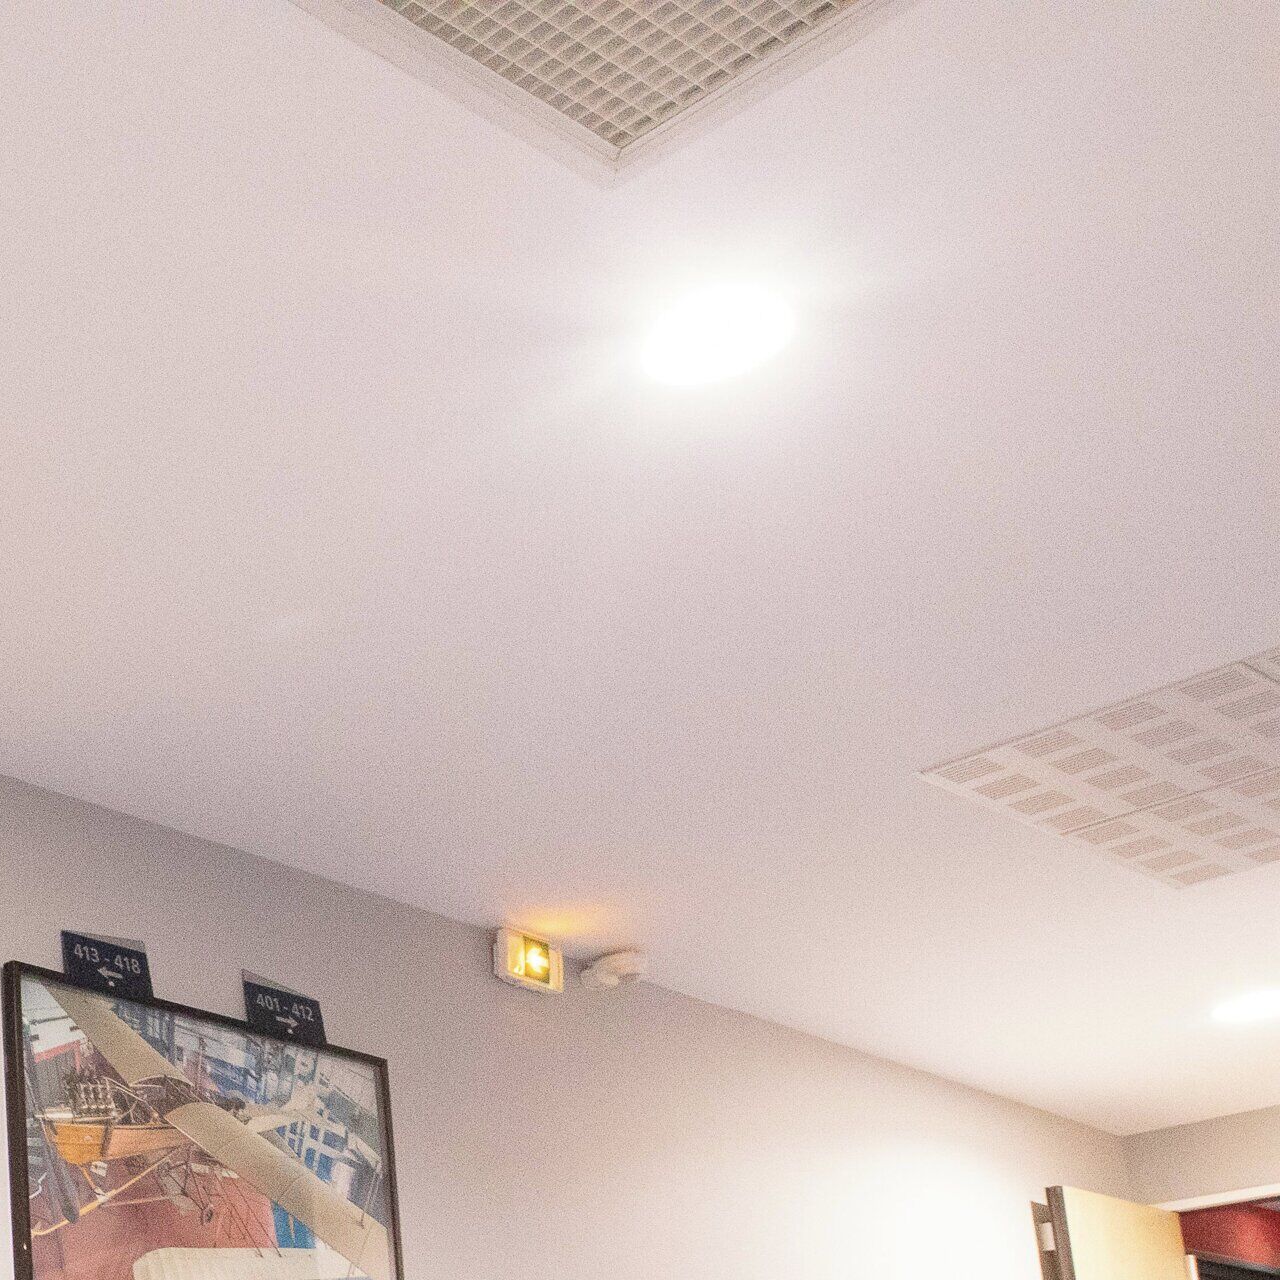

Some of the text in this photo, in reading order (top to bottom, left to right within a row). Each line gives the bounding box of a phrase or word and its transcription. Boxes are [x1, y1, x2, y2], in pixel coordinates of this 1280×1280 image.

[73, 943, 100, 963] 413
[114, 954, 141, 975] 418
[256, 993, 281, 1013] 401
[291, 1002, 314, 1022] 412
